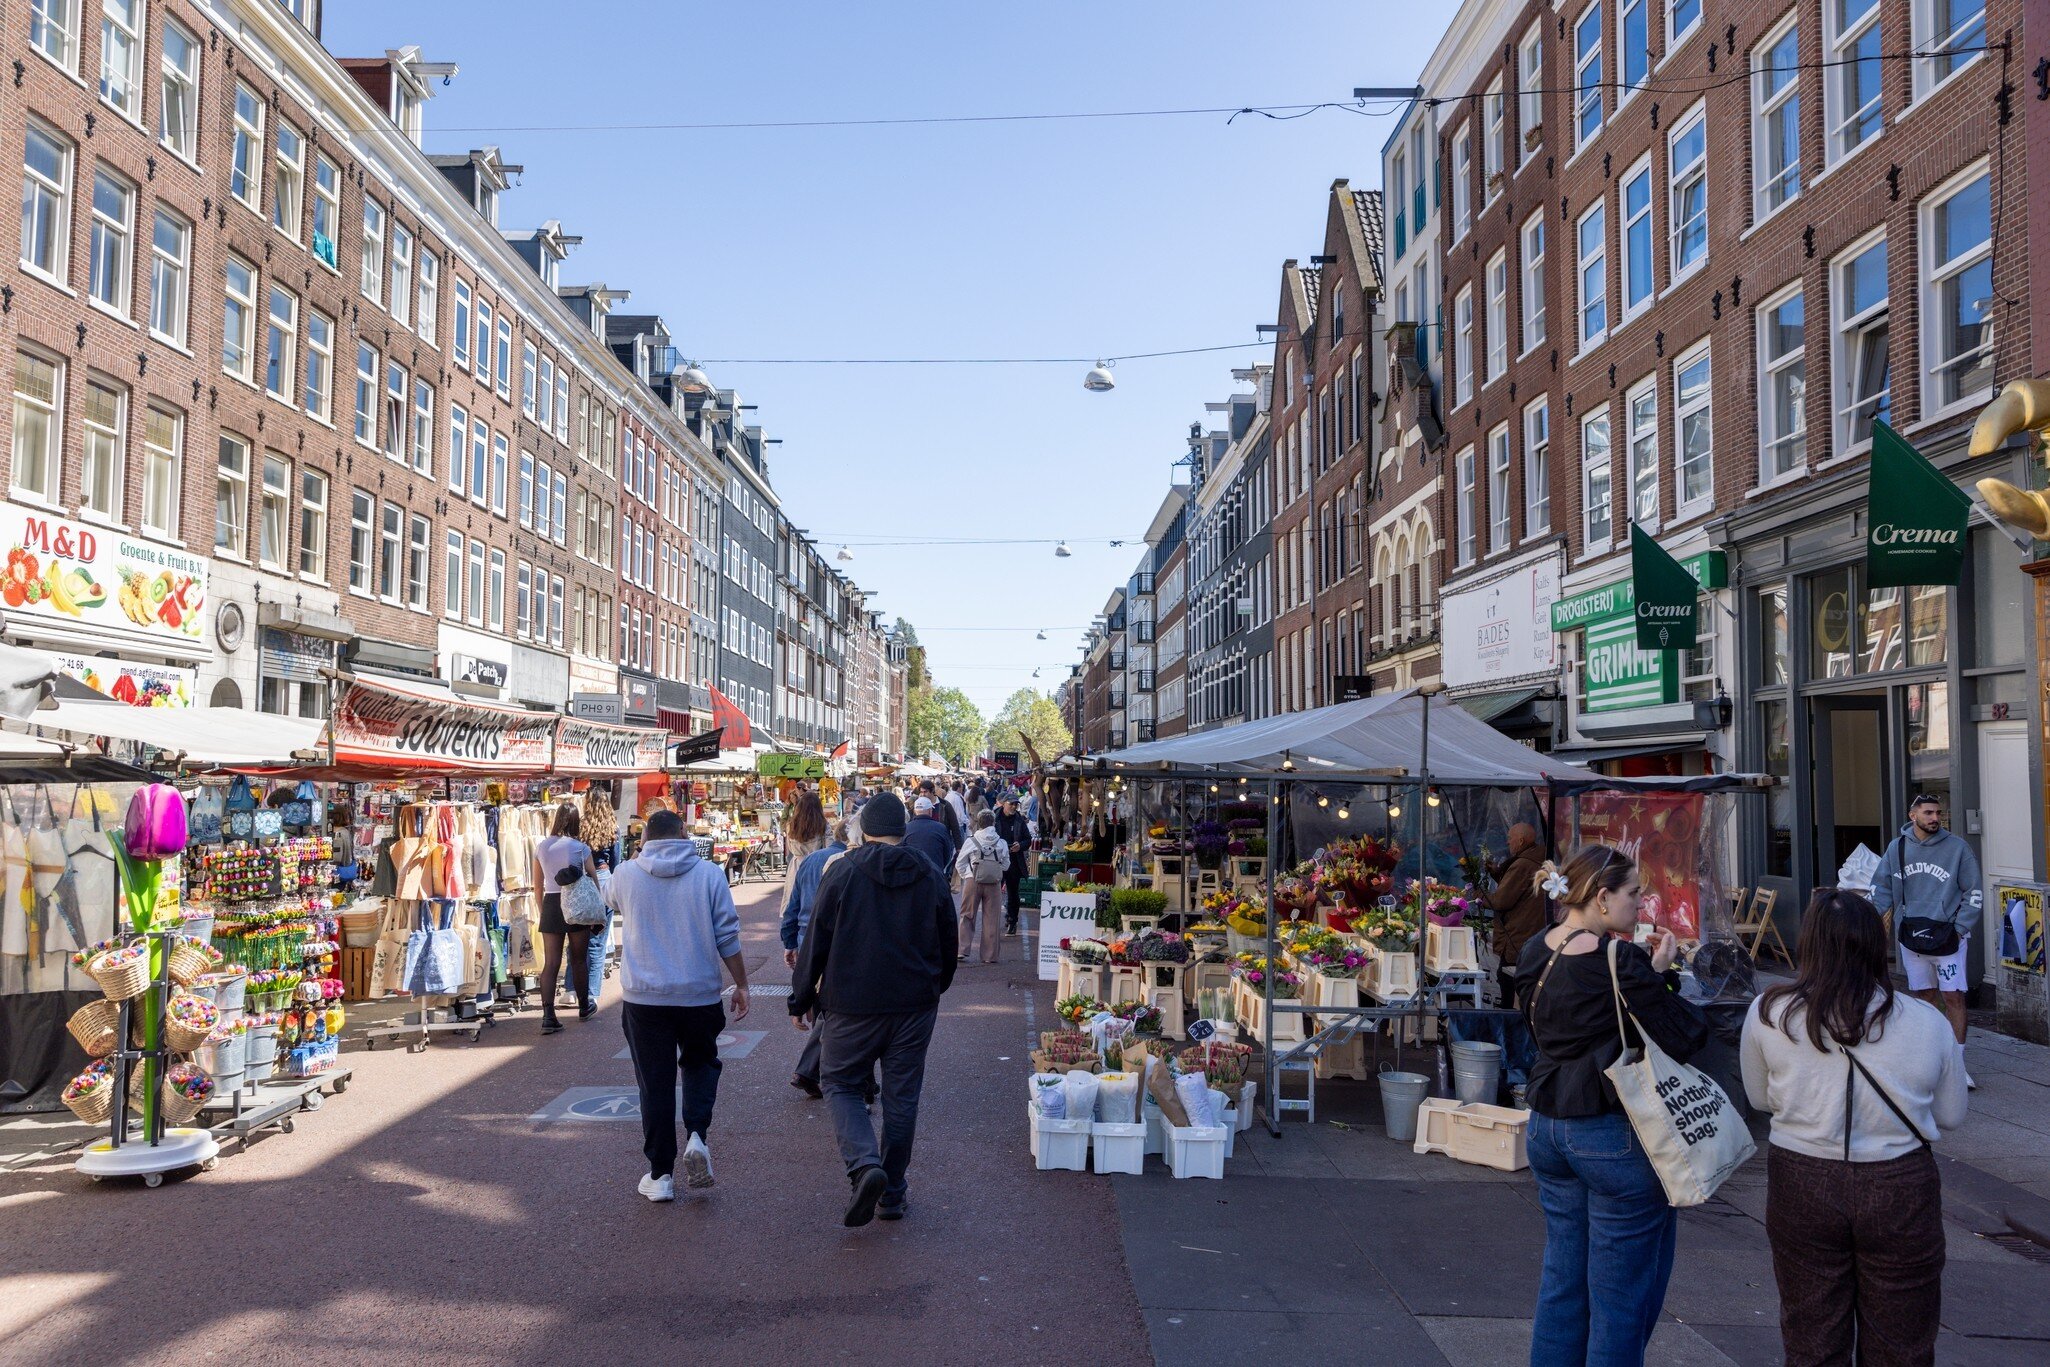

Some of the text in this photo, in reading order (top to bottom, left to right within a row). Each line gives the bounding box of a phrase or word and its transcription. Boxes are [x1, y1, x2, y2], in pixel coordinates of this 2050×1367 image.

[23, 517, 96, 563] M&D
[1872, 523, 1959, 545] Crema
[120, 541, 204, 575] Groente & Fruit B.V.
[1556, 588, 1614, 624] DROGISTERIJ
[1638, 601, 1692, 617] Crema
[1478, 621, 1509, 646] BADES
[469, 661, 477, 675] De
[1588, 639, 1660, 686] GRIMME
[605, 705, 615, 713] 91
[396, 714, 504, 760] souvenirs
[585, 737, 638, 767] souvenirs
[1894, 862, 1950, 882] WRLDWIDE
[1655, 1075, 1681, 1099] the
